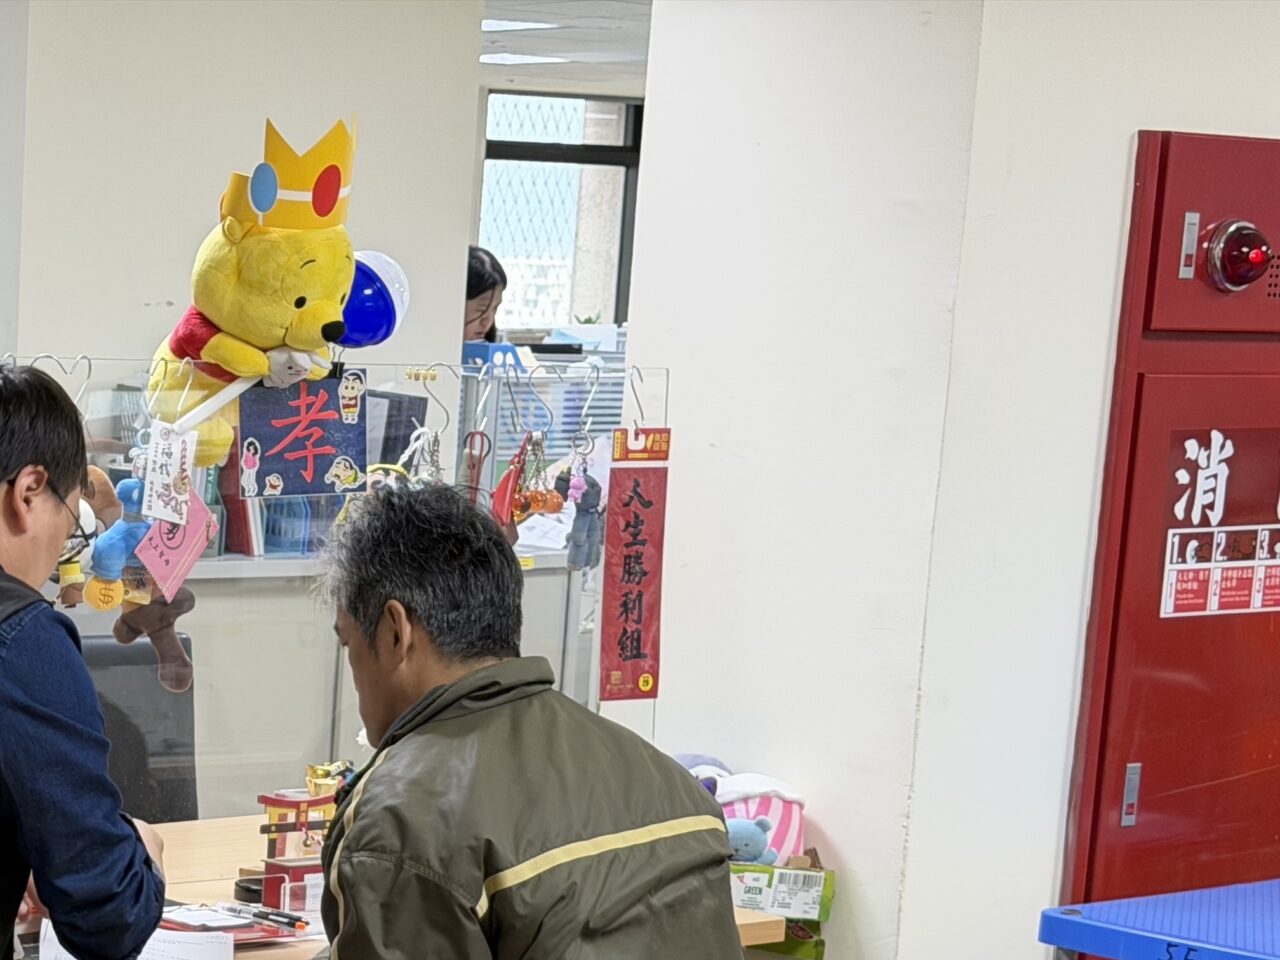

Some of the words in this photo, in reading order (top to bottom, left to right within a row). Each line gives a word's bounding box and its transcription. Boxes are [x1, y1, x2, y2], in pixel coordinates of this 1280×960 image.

[265, 381, 339, 483] 孝
[1217, 533, 1227, 561] 2.
[1260, 530, 1271, 559] 3.
[616, 477, 654, 662] 人生勝利組
[743, 885, 763, 896] GREEN
